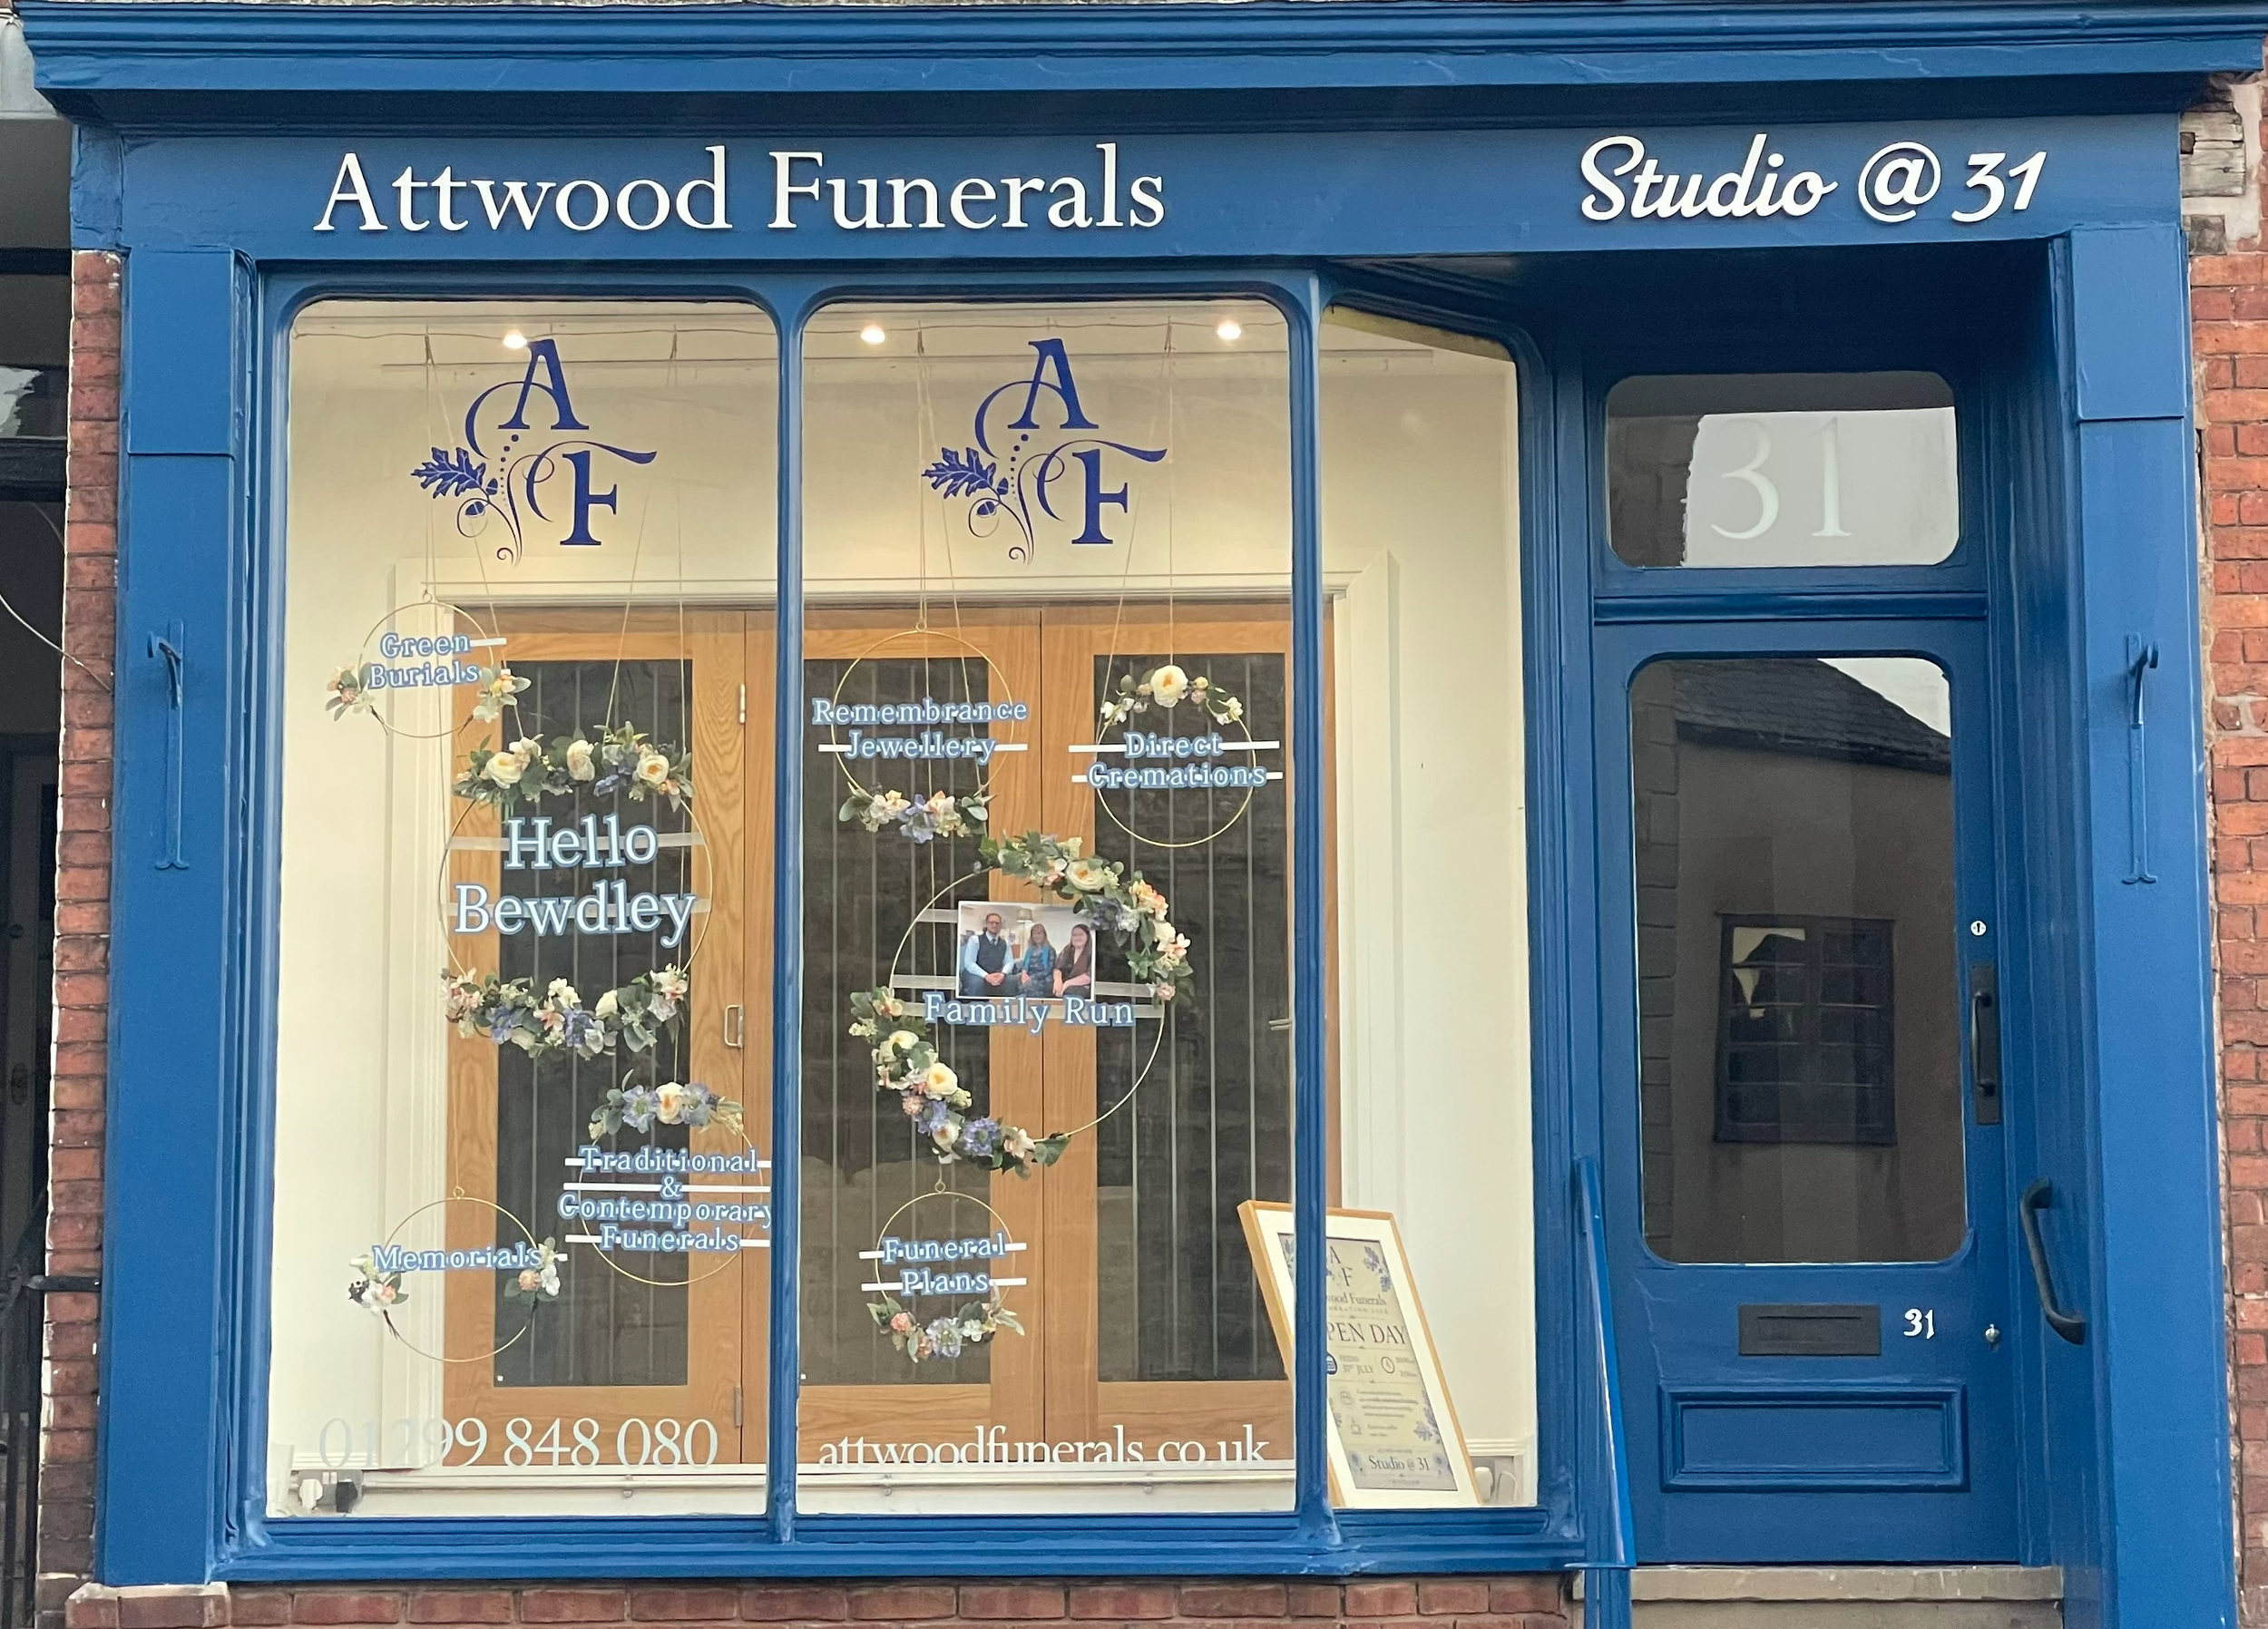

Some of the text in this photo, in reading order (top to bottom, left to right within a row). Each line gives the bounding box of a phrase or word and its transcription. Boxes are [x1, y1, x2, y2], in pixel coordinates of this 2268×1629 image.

[313, 142, 1164, 231] Attwood Funerals
[1580, 133, 2048, 223] Studio @ 31
[1710, 417, 1853, 540] 31
[379, 632, 471, 658] Green
[368, 661, 480, 689] Burials
[813, 697, 1028, 726] Remembrance
[846, 730, 997, 765] Jewellery
[1124, 731, 1224, 759] Direct
[1087, 763, 1268, 789] Cremations
[504, 813, 659, 870] Hello
[454, 879, 697, 950] Bewdley
[924, 991, 1135, 1036] Family Run
[579, 1145, 758, 1174] Traditional
[660, 1175, 681, 1199] &
[558, 1194, 771, 1230] Contemporary
[600, 1224, 741, 1253] Funerals
[882, 1231, 1007, 1264] Funeral
[372, 1241, 542, 1273] Memorials
[900, 1267, 991, 1296] Plans
[1327, 1322, 1406, 1345] PEN DAY
[1903, 1307, 1936, 1341] 31
[319, 1417, 718, 1469] 01299 848 080
[1368, 1455, 1405, 1470] Studio
[1417, 1457, 1431, 1471] 31
